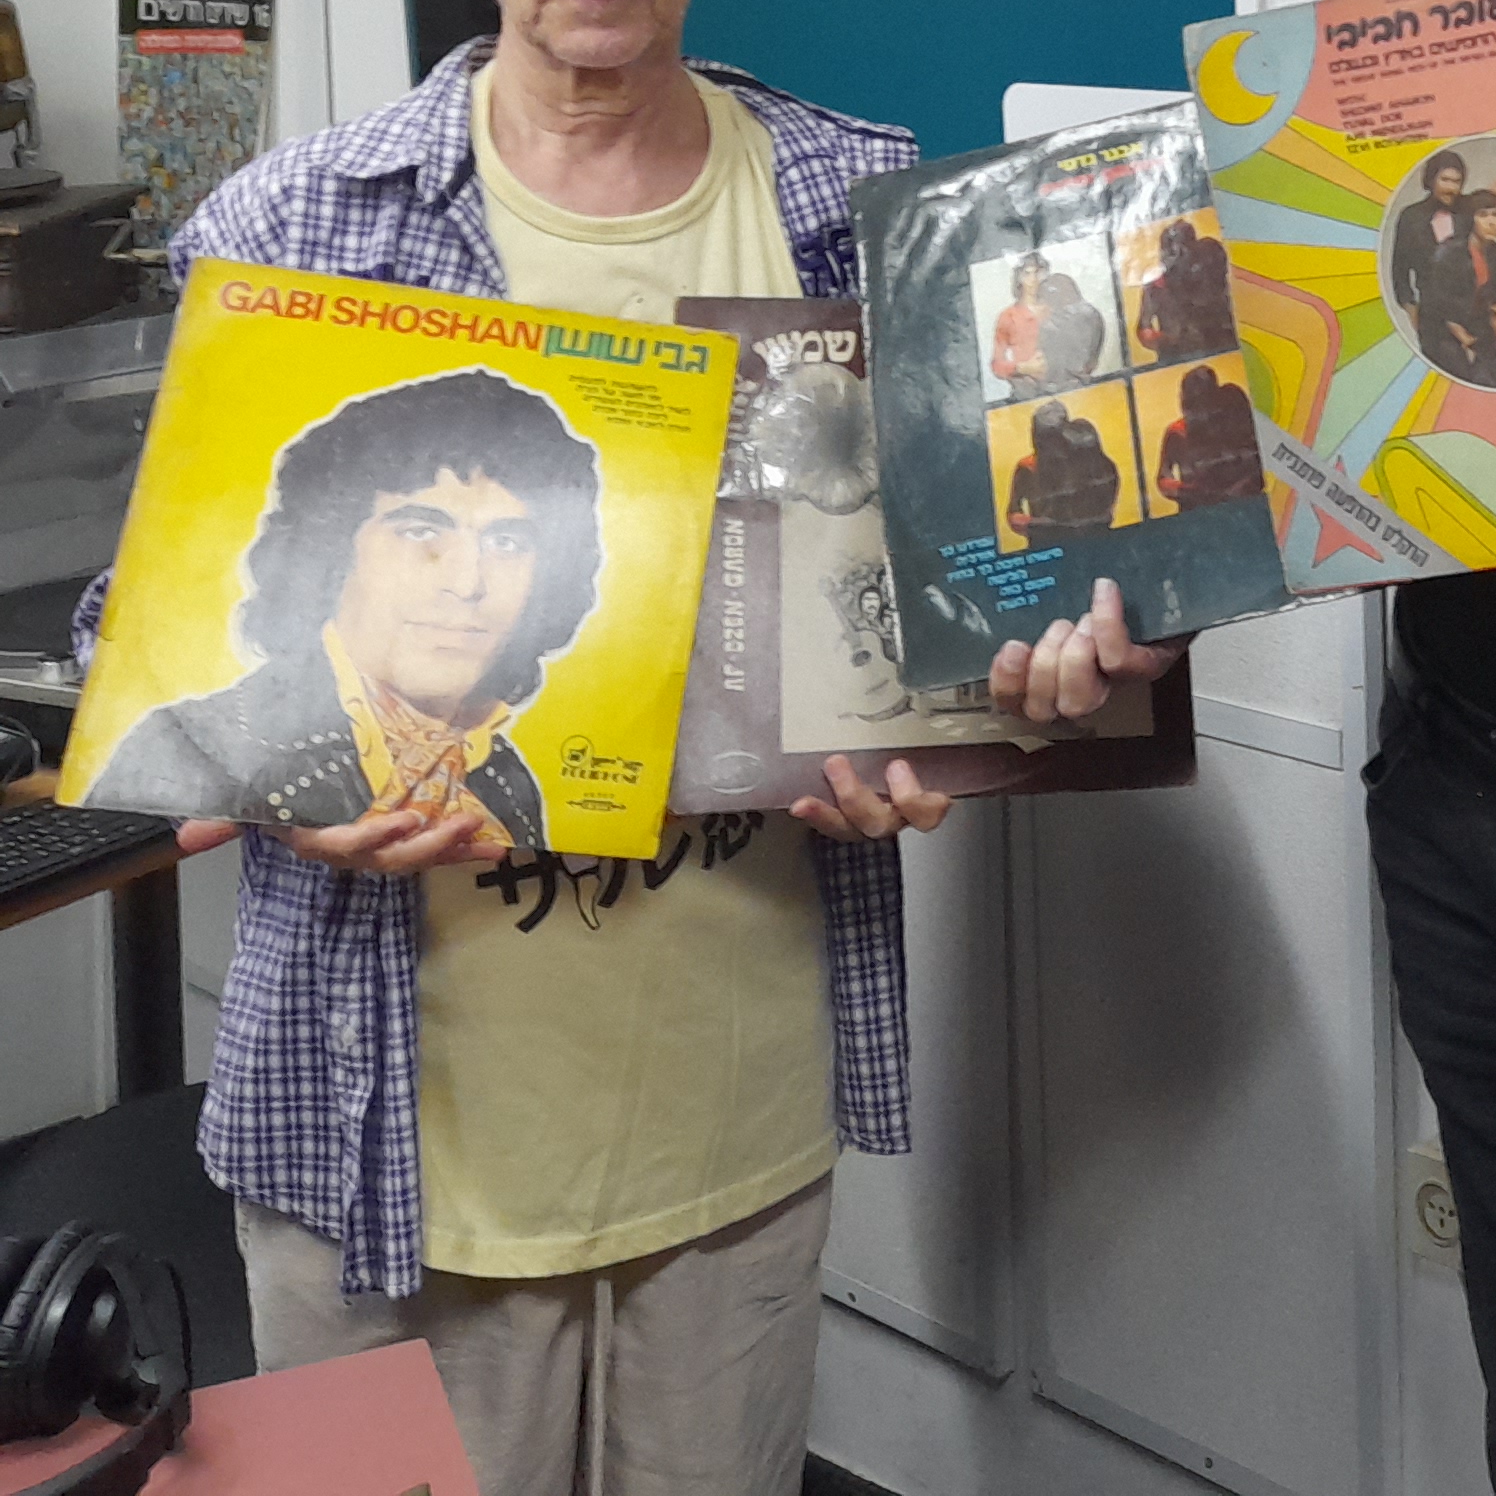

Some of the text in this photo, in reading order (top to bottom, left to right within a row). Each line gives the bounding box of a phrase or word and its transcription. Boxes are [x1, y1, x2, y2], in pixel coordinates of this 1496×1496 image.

[1325, 9, 1420, 51] חביבי
[219, 280, 543, 352] GABI SHOSHAN
[542, 325, 710, 375] גבי שושן
